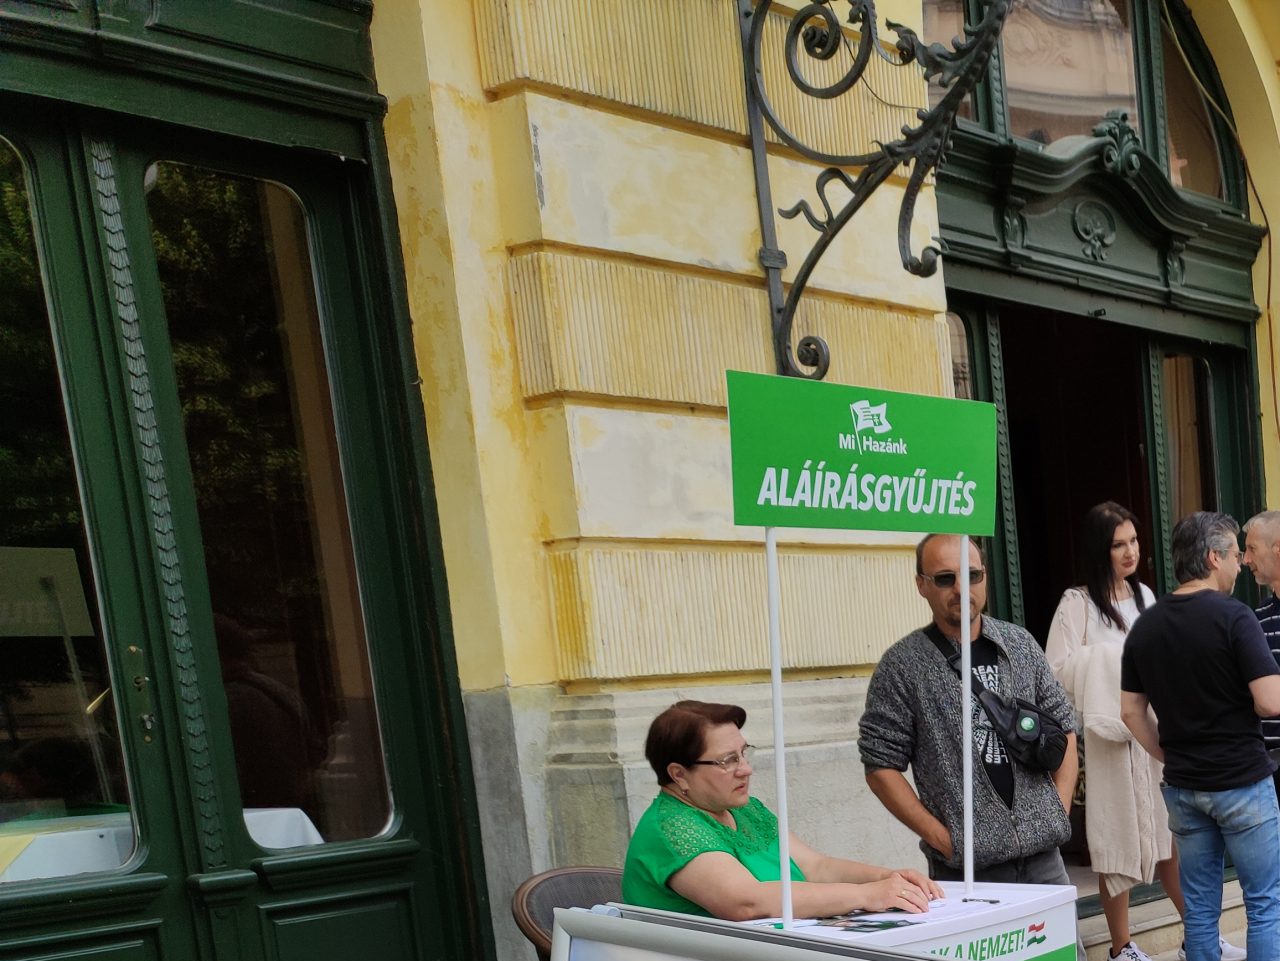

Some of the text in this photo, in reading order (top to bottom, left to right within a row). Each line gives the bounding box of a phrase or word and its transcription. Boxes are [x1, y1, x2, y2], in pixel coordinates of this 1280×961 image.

[838, 433, 907, 454] Mi Hazánk
[757, 459, 976, 516] ALÁÍRÁSGYŰJTÉS
[968, 928, 1026, 961] NEMZET!
